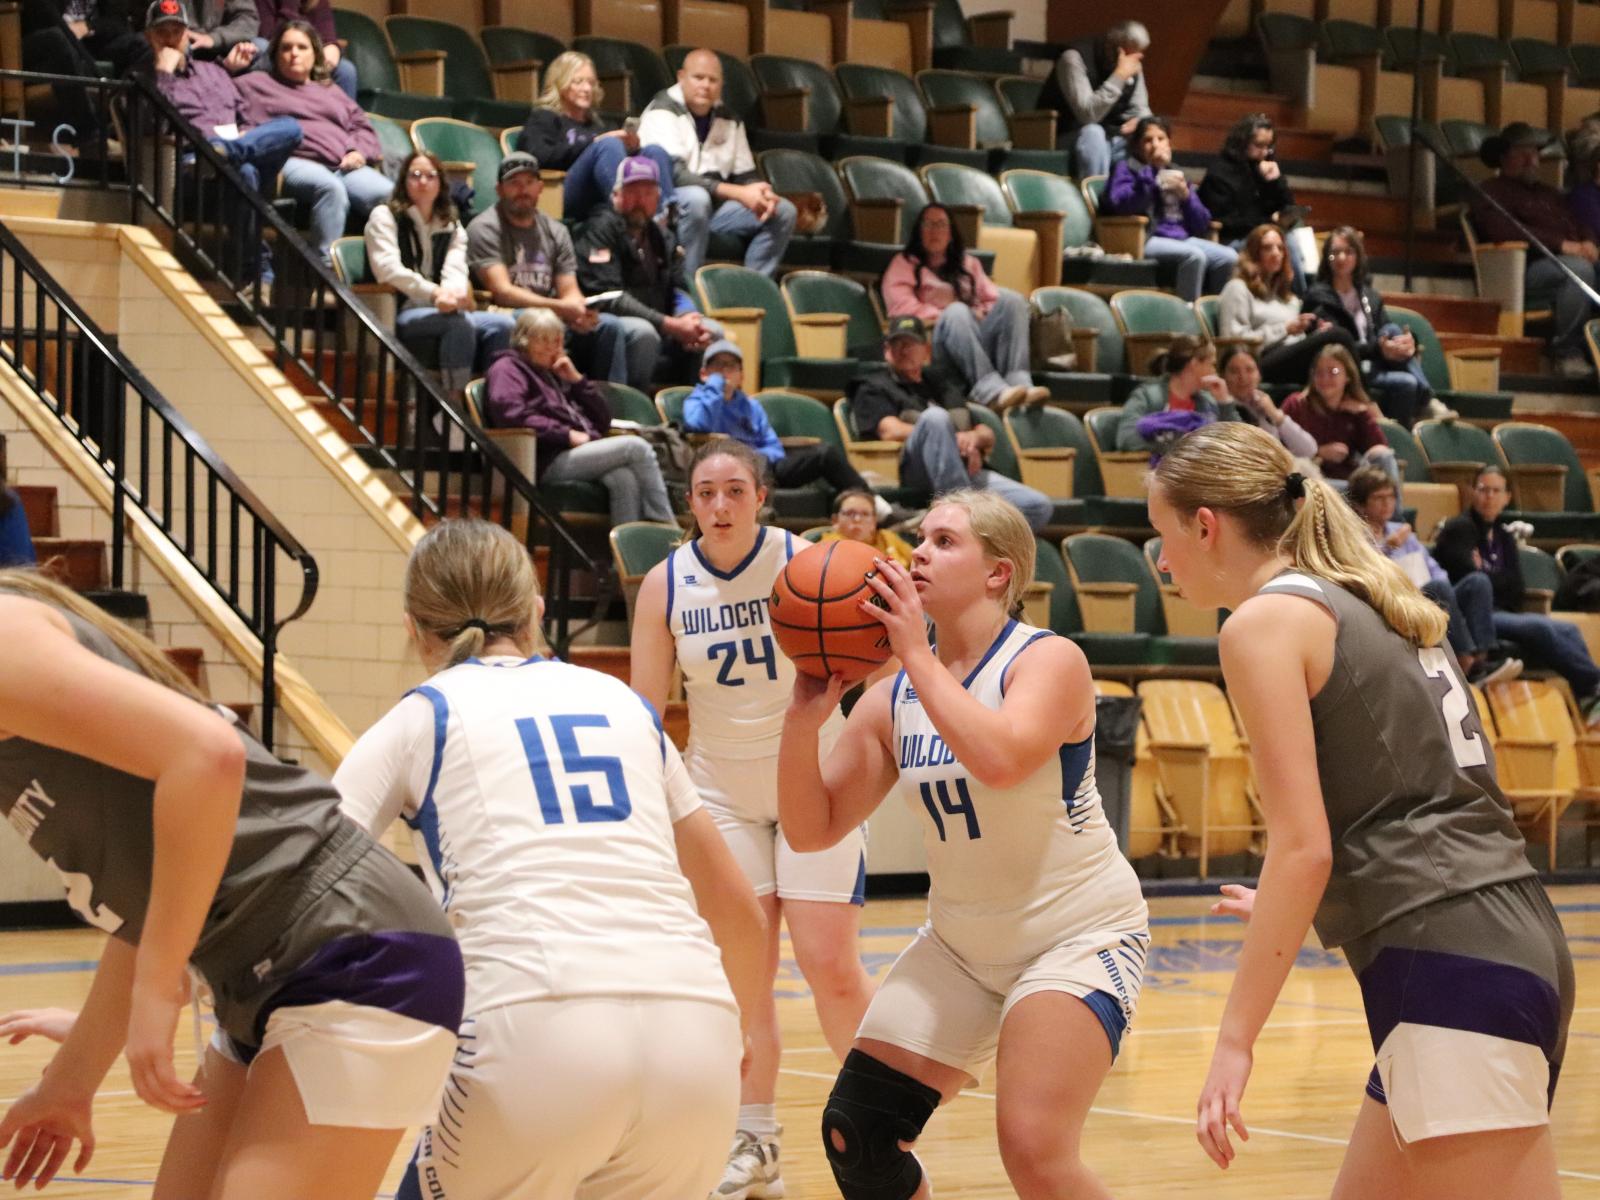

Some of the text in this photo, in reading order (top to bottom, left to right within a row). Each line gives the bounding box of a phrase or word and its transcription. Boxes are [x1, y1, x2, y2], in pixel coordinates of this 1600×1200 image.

[707, 635, 778, 686] 24
[1418, 647, 1487, 768] 2
[514, 714, 632, 825] 15
[919, 778, 982, 842] 14
